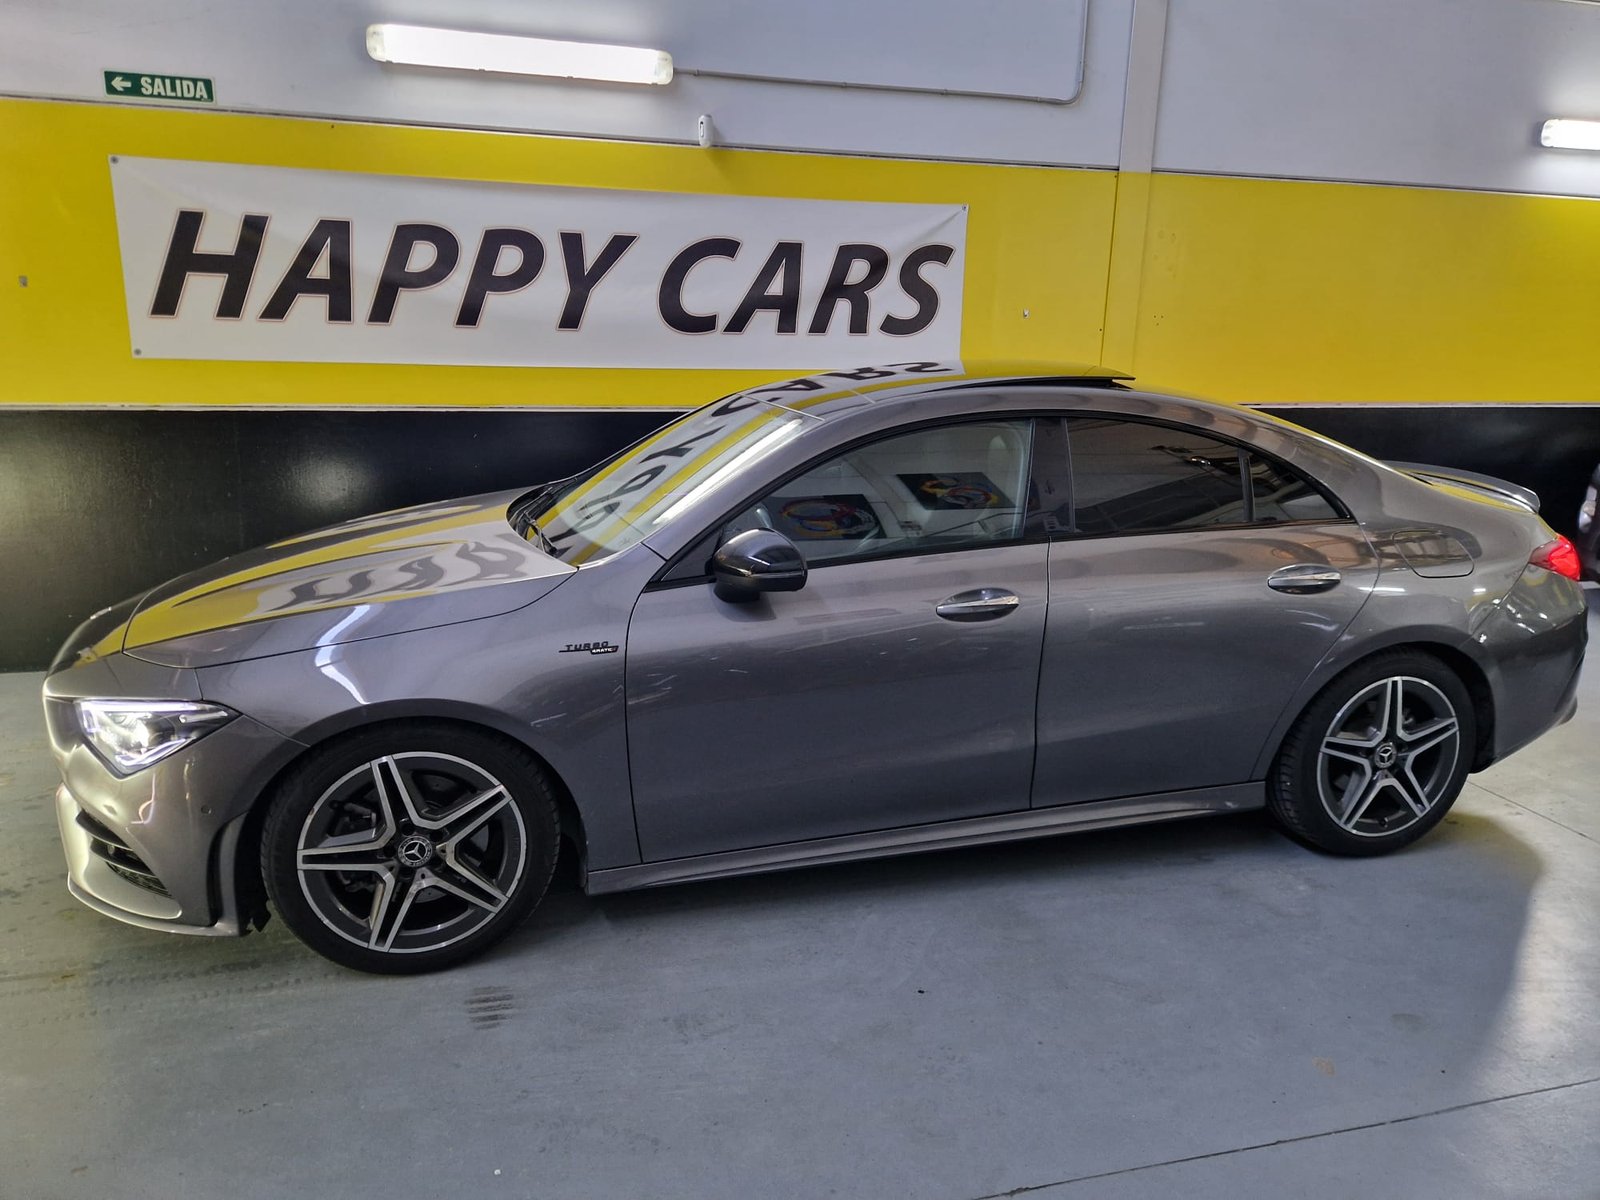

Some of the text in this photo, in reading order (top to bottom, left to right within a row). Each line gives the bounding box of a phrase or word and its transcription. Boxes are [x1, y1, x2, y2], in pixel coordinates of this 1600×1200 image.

[140, 76, 208, 99] SALIDA
[150, 210, 955, 337] HAPPY CARS
[565, 641, 609, 651] TURBO
